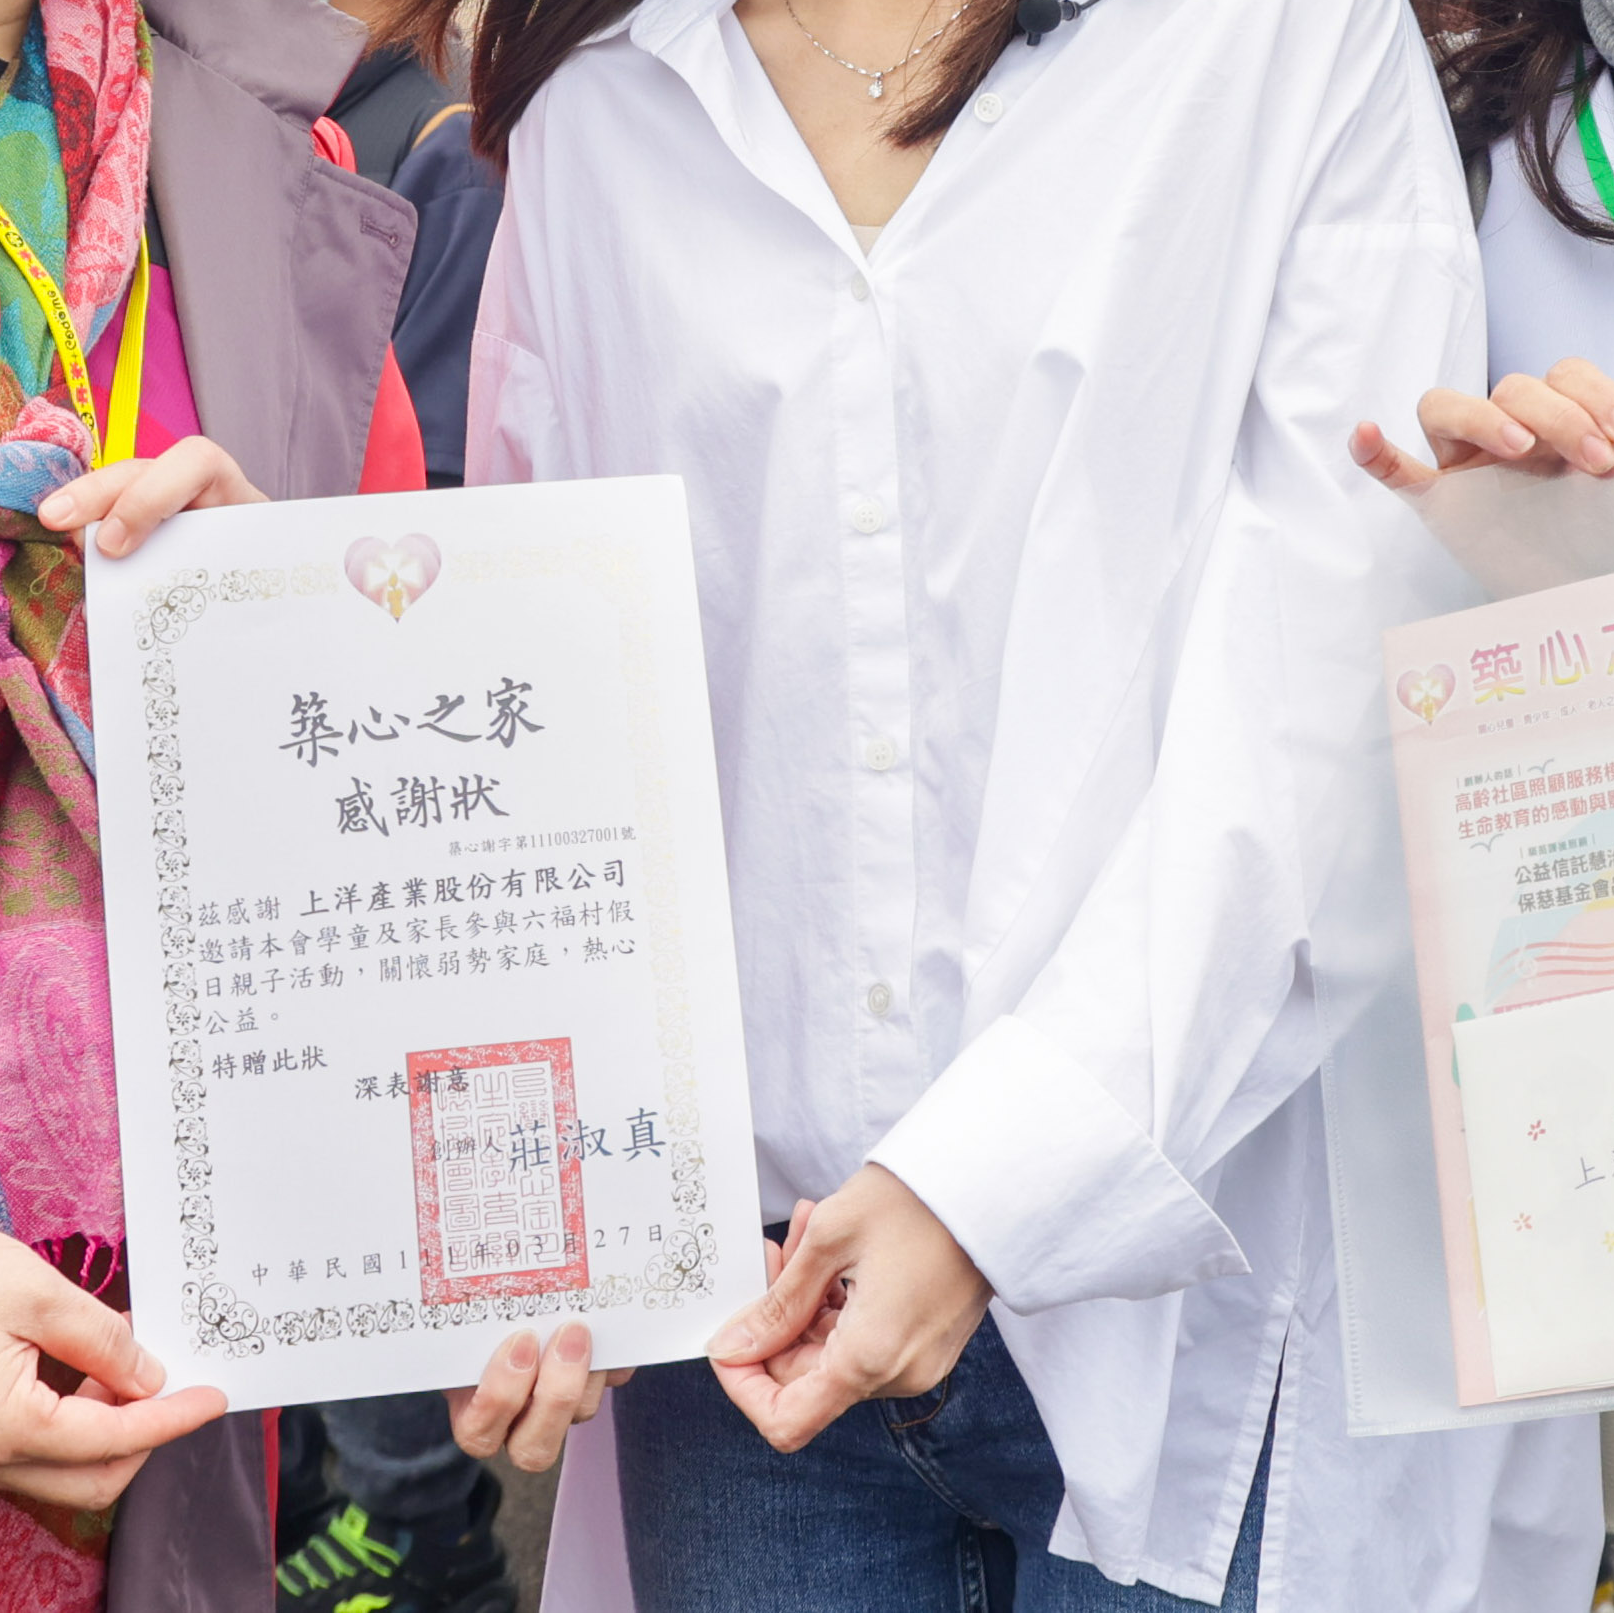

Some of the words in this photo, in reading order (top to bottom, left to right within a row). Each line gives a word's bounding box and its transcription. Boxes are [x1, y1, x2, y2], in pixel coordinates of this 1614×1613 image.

[279, 677, 545, 768] 築心之家
[336, 774, 510, 837] 感謝狀
[448, 825, 637, 857] 築心謝字第11100327001號
[300, 859, 625, 916] 上洋產業股份有限公司
[199, 899, 635, 964] 邀請本會學童及家長參與六福村假
[212, 1045, 328, 1080] 特贈此狀
[355, 1065, 469, 1101] 深表謝意
[509, 1107, 667, 1173] 莊淑真
